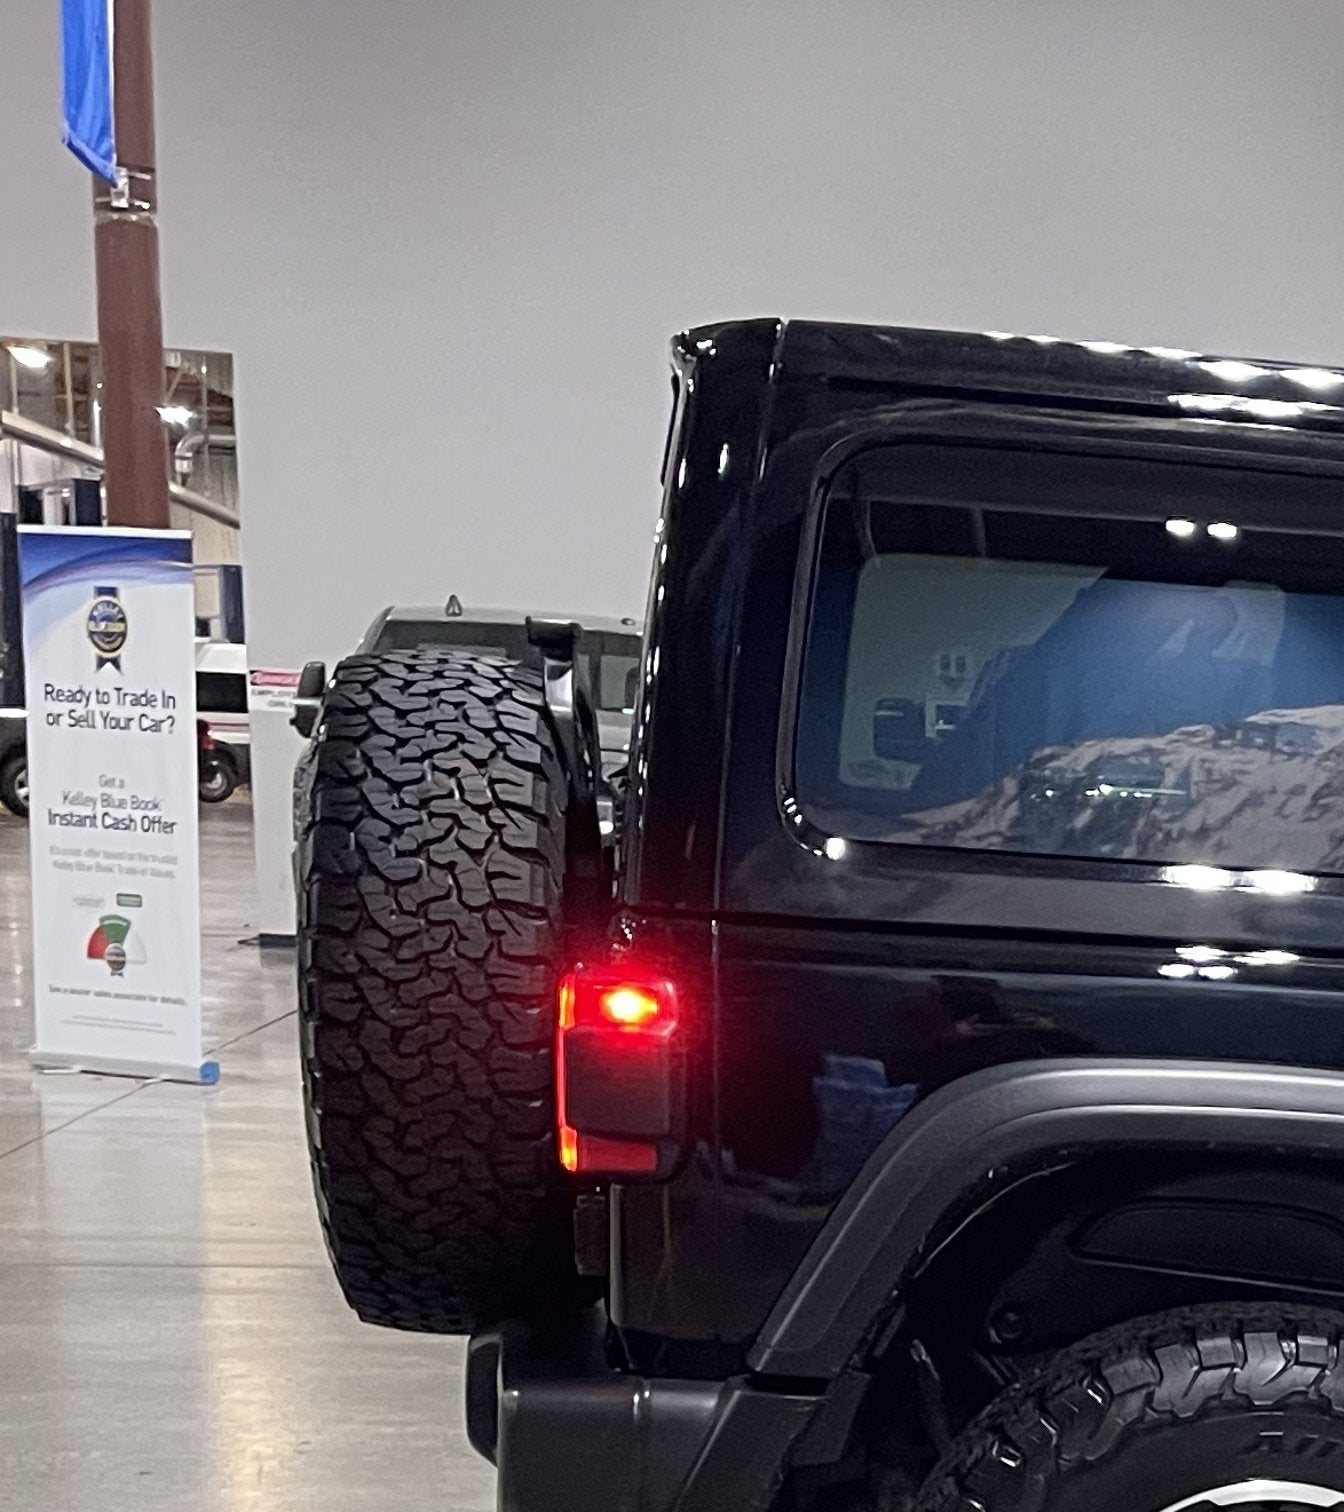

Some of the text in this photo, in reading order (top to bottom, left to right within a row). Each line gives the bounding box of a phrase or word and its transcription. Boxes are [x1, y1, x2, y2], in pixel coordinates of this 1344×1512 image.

[44, 683, 176, 709] Ready to Trade In
[46, 709, 175, 734] or Sell Your Car?
[100, 792, 127, 810] Blue
[48, 808, 177, 834] Instant Cash Offer
